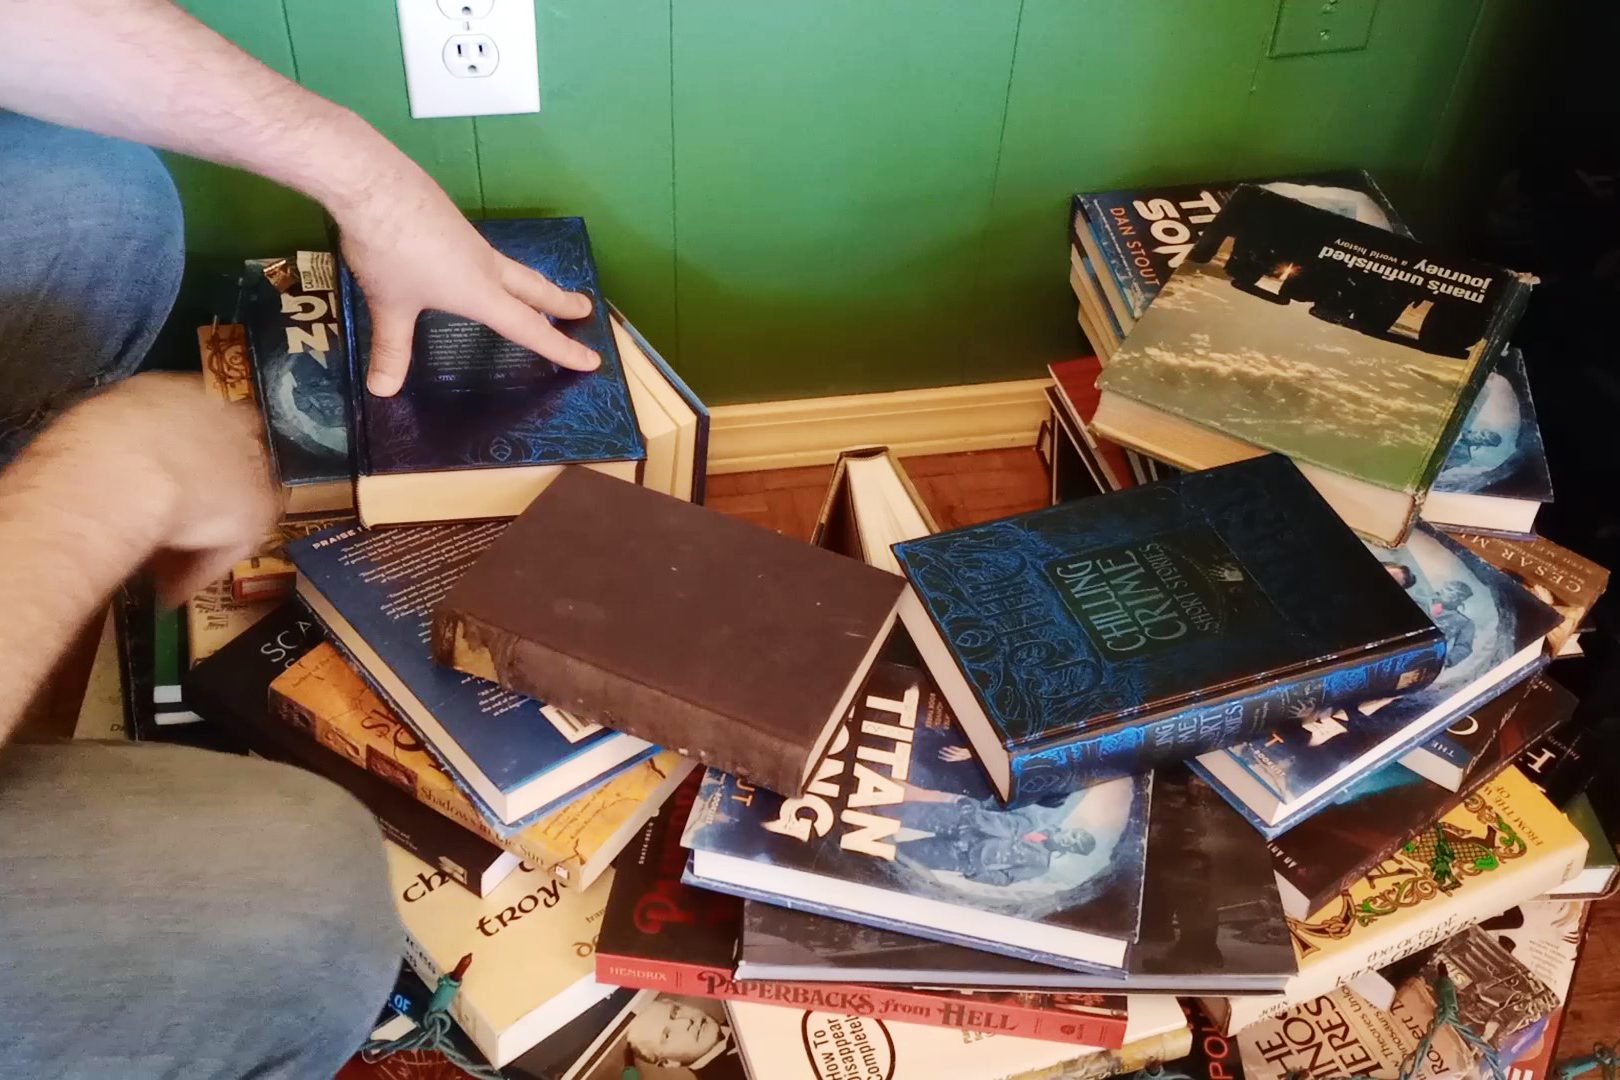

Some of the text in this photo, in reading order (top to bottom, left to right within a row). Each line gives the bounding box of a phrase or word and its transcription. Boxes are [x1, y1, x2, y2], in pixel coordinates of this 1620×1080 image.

[1110, 207, 1161, 287] DAN STOUT
[1334, 238, 1368, 256] history
[1369, 250, 1398, 264] world
[1318, 245, 1486, 304] man's unfinished
[1413, 258, 1493, 294] journey
[312, 530, 356, 550] PRAISE
[1096, 550, 1187, 641] CRIME
[1139, 543, 1219, 633] SHORT STORIES
[1501, 548, 1581, 593] CESAR
[1057, 560, 1147, 651] CHILLING
[840, 683, 920, 861] TITAN
[1433, 740, 1454, 758] THE
[519, 843, 544, 866] Sun
[1513, 817, 1543, 846] FROM
[476, 879, 568, 937] troy
[609, 966, 668, 982] HENDRIX
[697, 971, 875, 1015] PAPERBACKS
[879, 998, 931, 1018] from
[937, 1000, 1019, 1032] HELL
[813, 1030, 844, 1080] How To
[849, 1014, 884, 1080] Completel
[1361, 1013, 1394, 1058] Theories
[1402, 1016, 1450, 1075] Roert
